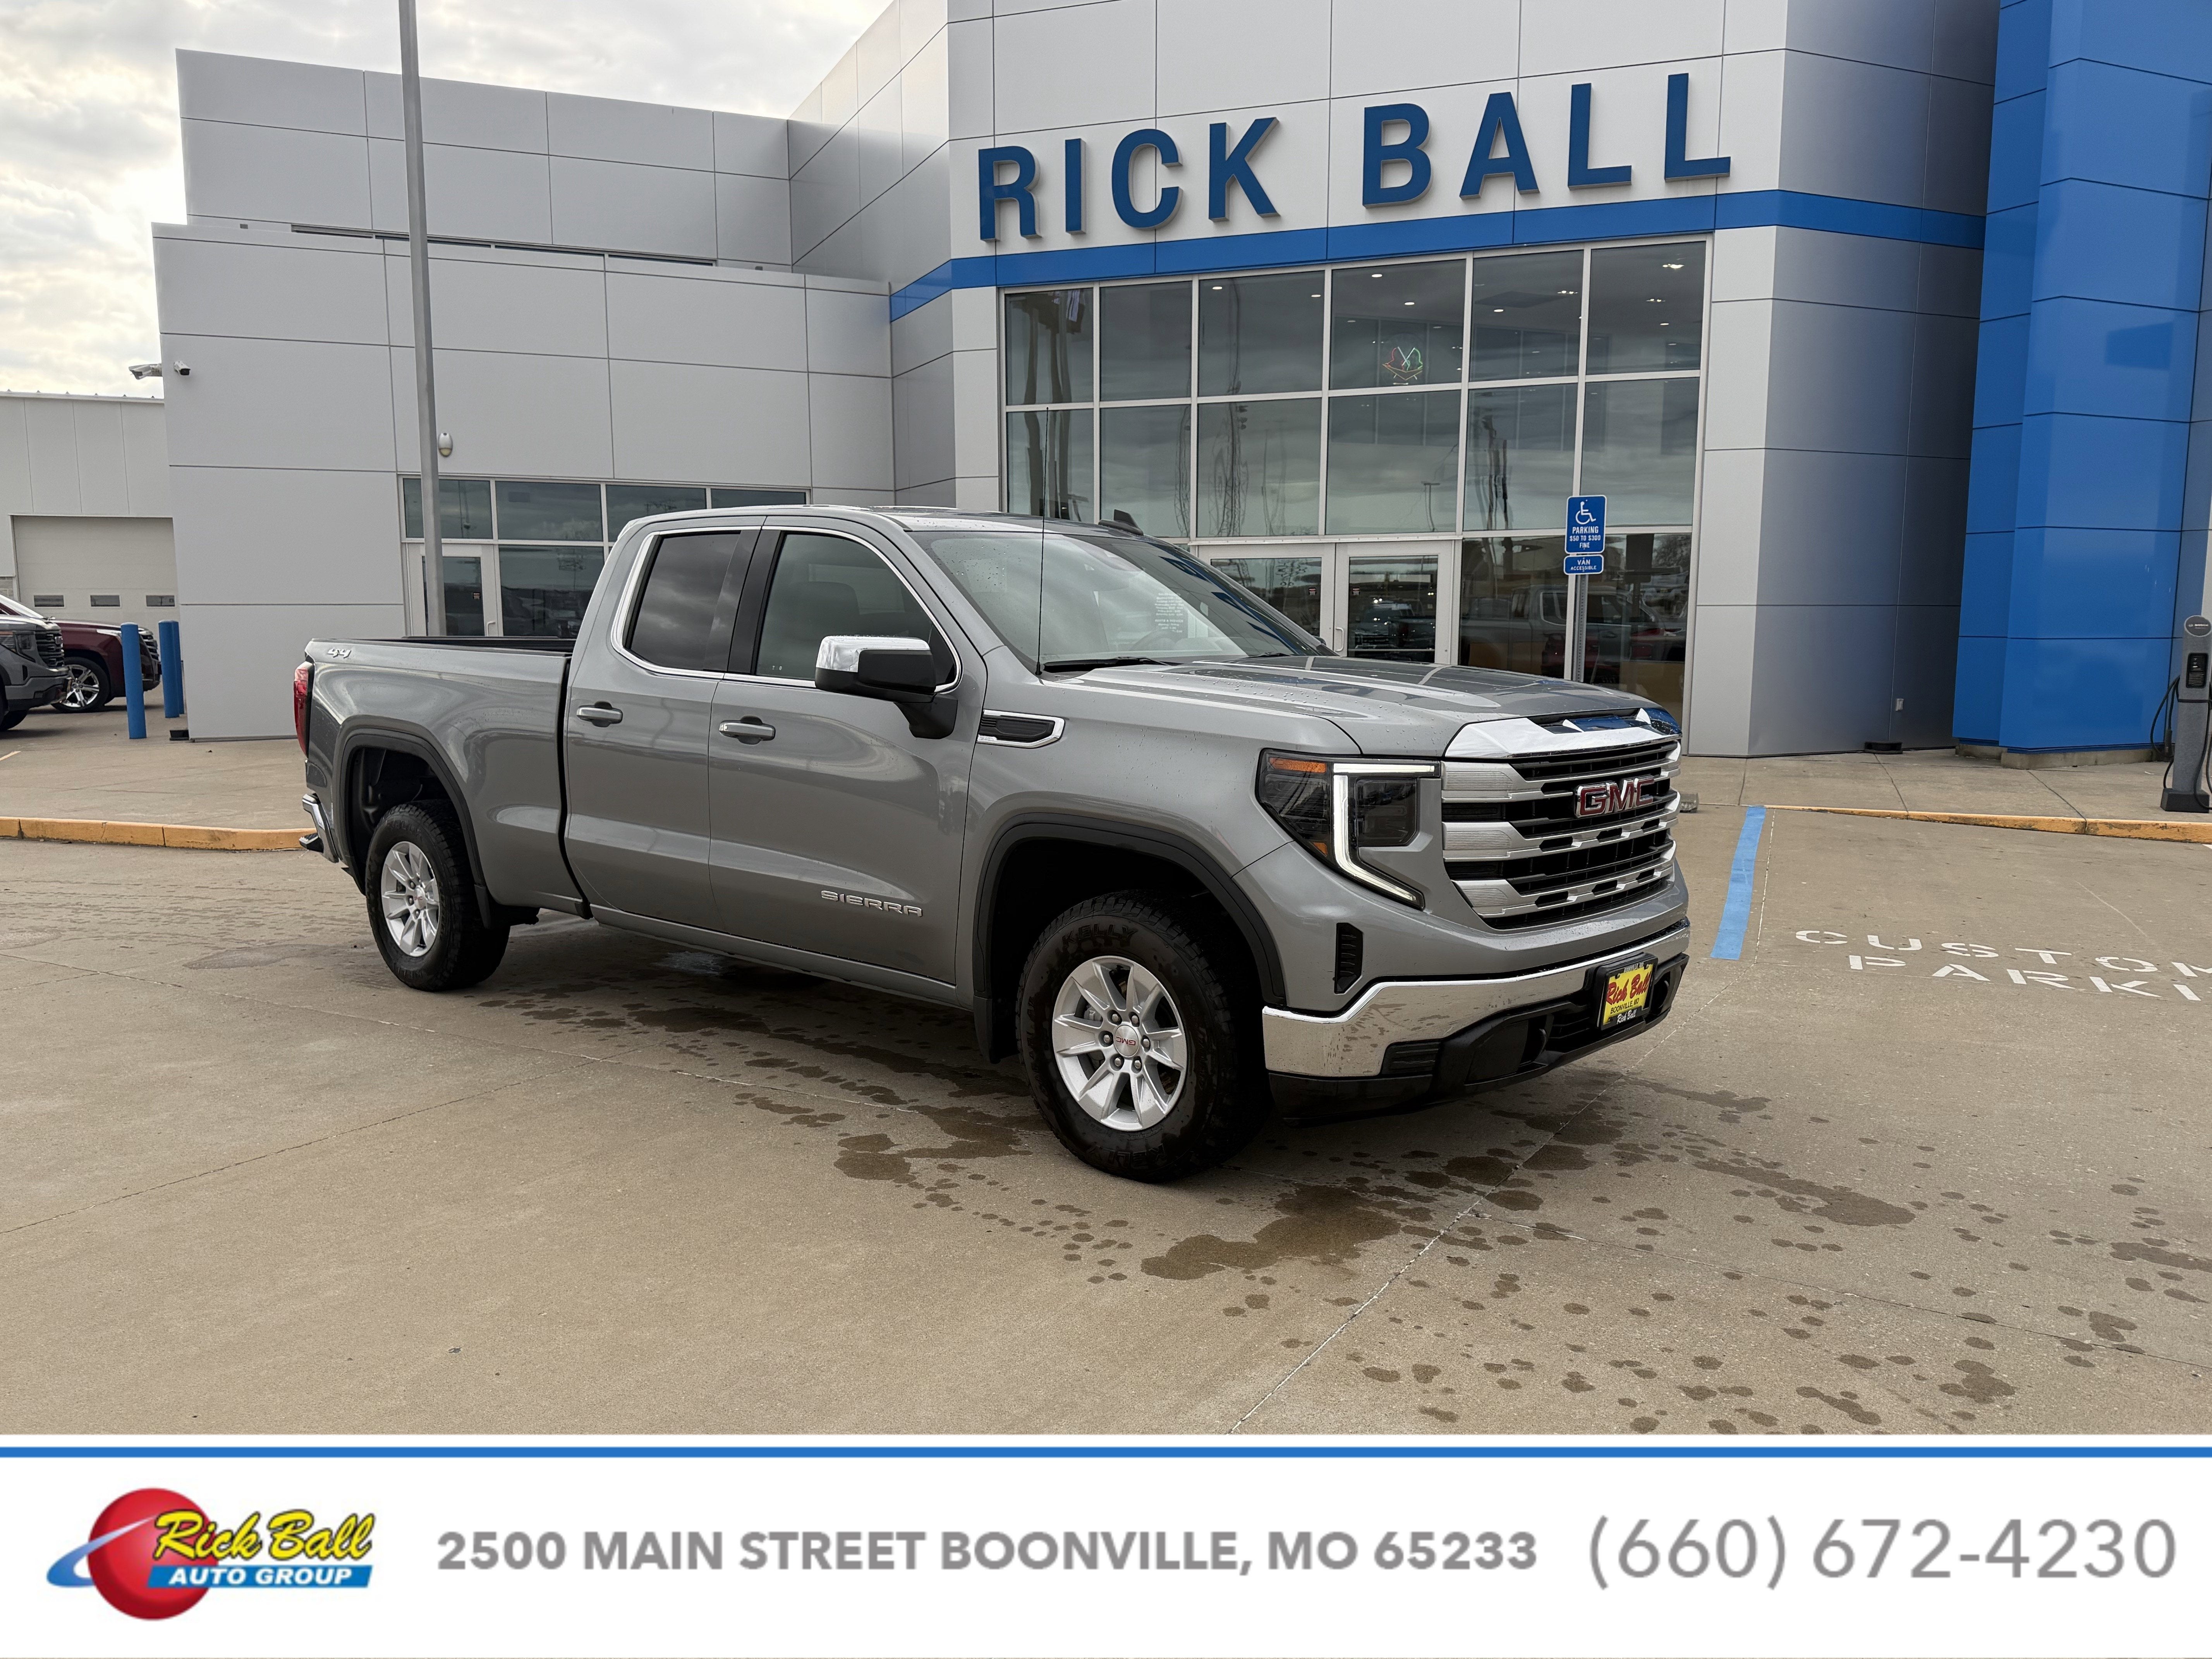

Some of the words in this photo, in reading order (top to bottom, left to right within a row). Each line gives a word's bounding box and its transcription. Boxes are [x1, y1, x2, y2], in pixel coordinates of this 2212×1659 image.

[979, 116, 1280, 242] RICK
[1362, 72, 1731, 209] BALL
[1572, 526, 1599, 534] PARKING
[1575, 776, 1655, 818] GMC
[821, 890, 923, 917] SIERRA
[1062, 923, 1139, 947] KELLY
[1606, 979, 1629, 1005] Rick
[1630, 971, 1652, 999] Ball
[1849, 955, 2212, 1001] PARKI
[1116, 1036, 1136, 1046] GMC
